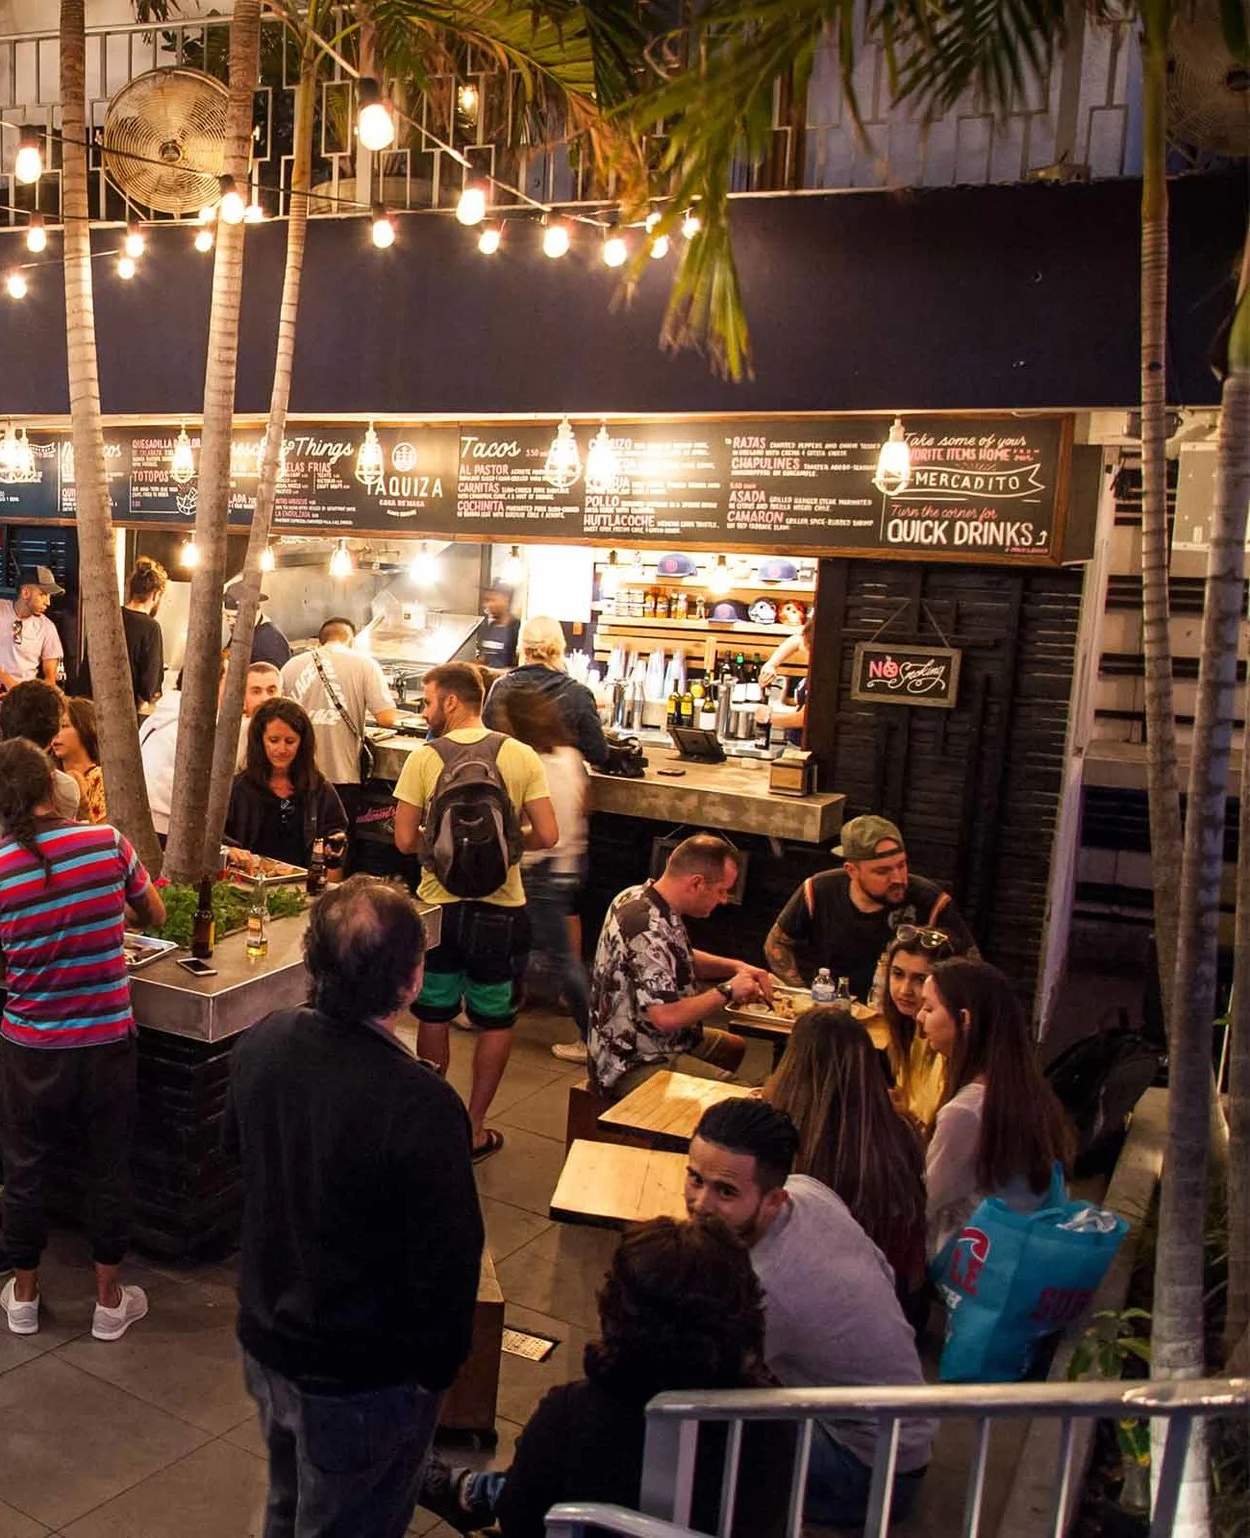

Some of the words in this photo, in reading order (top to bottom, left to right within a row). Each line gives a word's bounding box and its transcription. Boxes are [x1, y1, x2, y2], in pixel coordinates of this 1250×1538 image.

[460, 436, 521, 458] Tacos
[733, 436, 766, 449] RAJAS
[937, 436, 976, 446] some
[978, 433, 995, 448] of
[997, 436, 1027, 449] your
[295, 437, 354, 464] Things
[946, 448, 976, 461] ITEMS
[978, 448, 1011, 462] HOME
[459, 464, 471, 475] AL
[474, 464, 508, 475] PASTOR
[731, 457, 800, 470] CHAPULINES
[133, 470, 169, 482] TOTOPOS
[915, 471, 1020, 491] MERCADITO
[458, 482, 500, 493] CARNITAS
[585, 495, 619, 507] POLLO
[729, 490, 766, 503] ASADA
[457, 500, 504, 512] COCHINITA
[727, 511, 784, 523] CAMARON
[890, 504, 920, 518] Turn
[921, 505, 940, 518] the
[941, 507, 977, 519] corner
[978, 506, 998, 523] for
[584, 515, 655, 527] HUITLACOCHE
[887, 518, 949, 545] QUICK
[953, 520, 1034, 546] DRINKS
[869, 660, 899, 679] NO
[897, 659, 946, 693] Smoking
